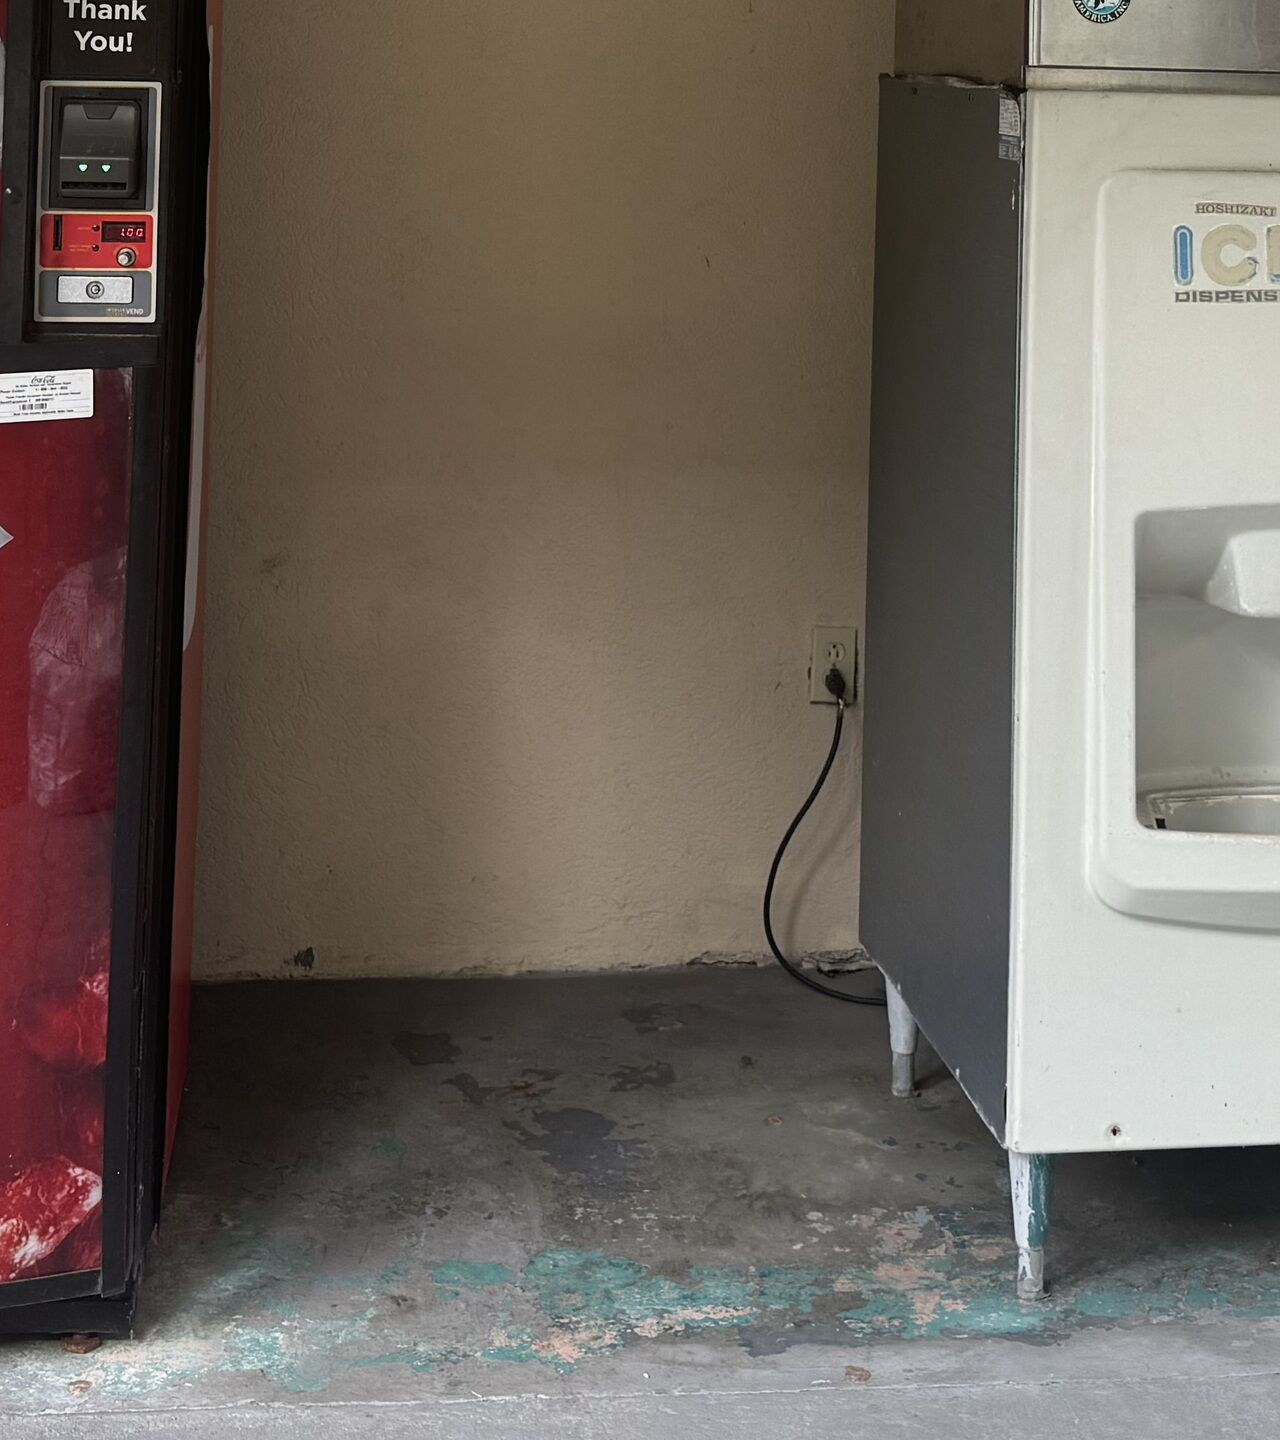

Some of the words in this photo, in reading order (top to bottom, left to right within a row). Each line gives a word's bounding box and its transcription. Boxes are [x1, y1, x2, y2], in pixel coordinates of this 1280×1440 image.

[73, 30, 133, 52] You!
[1195, 202, 1277, 217] HOSHIZAKI
[31, 375, 55, 384] Coca-Cola
